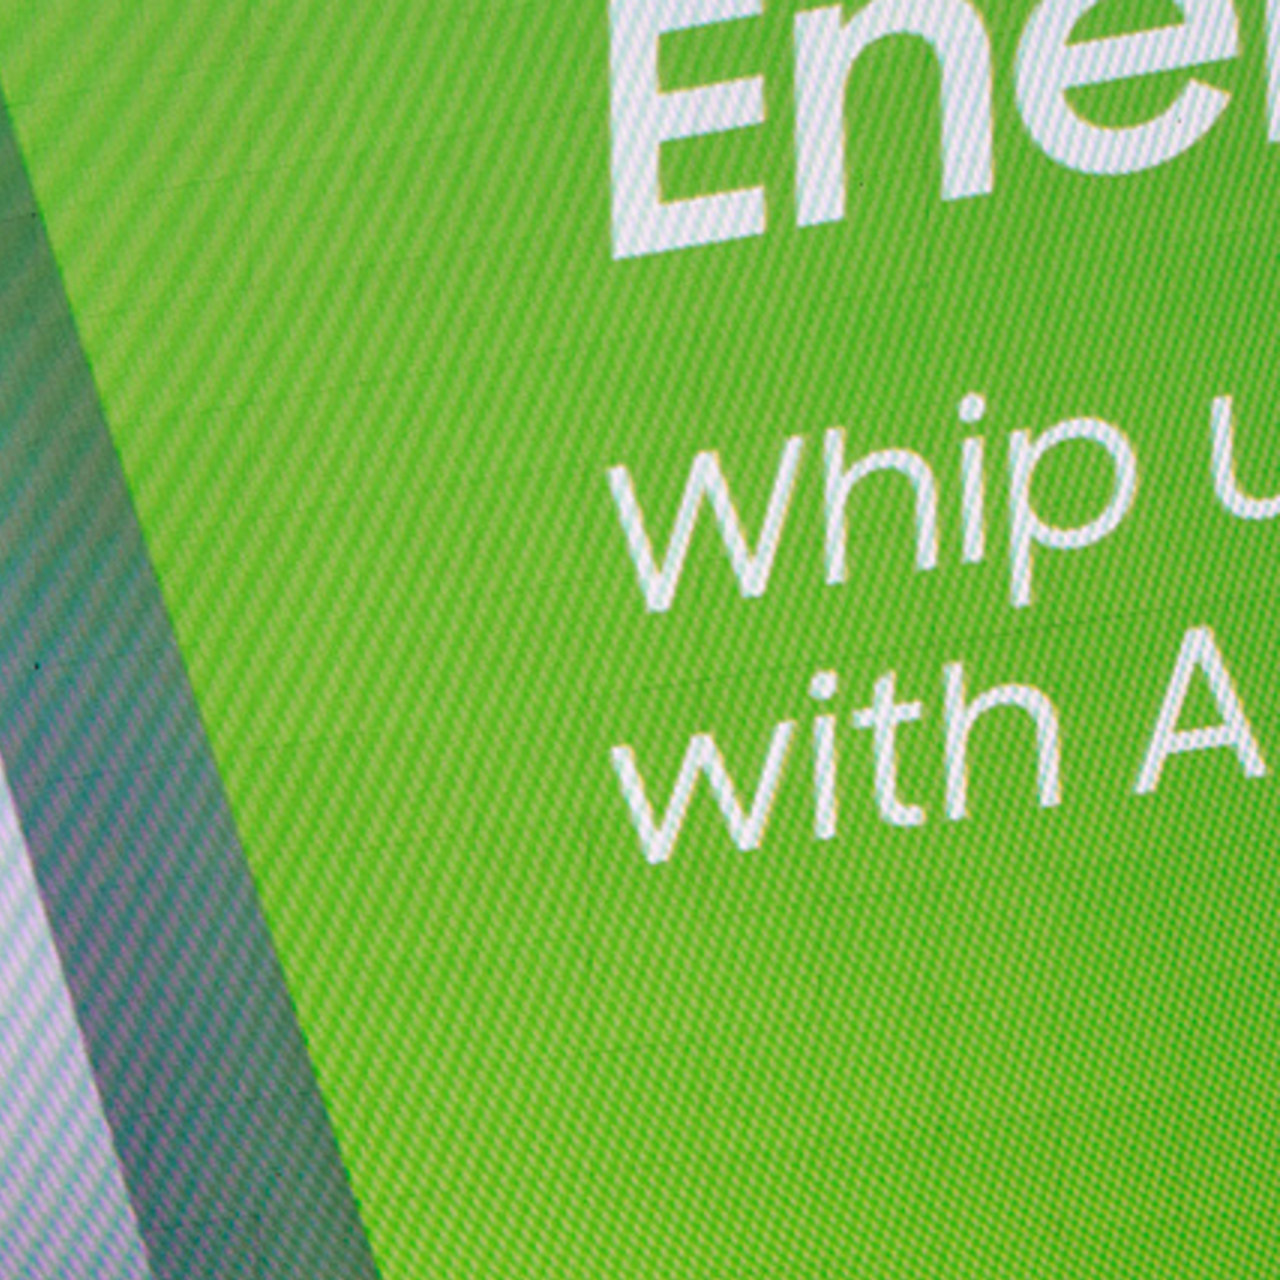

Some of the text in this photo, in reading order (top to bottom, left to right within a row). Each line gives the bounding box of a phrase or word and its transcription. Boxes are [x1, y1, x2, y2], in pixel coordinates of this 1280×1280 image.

[608, 0, 1280, 260] Ene
[606, 391, 1137, 613] Whip
[610, 662, 1062, 864] with
